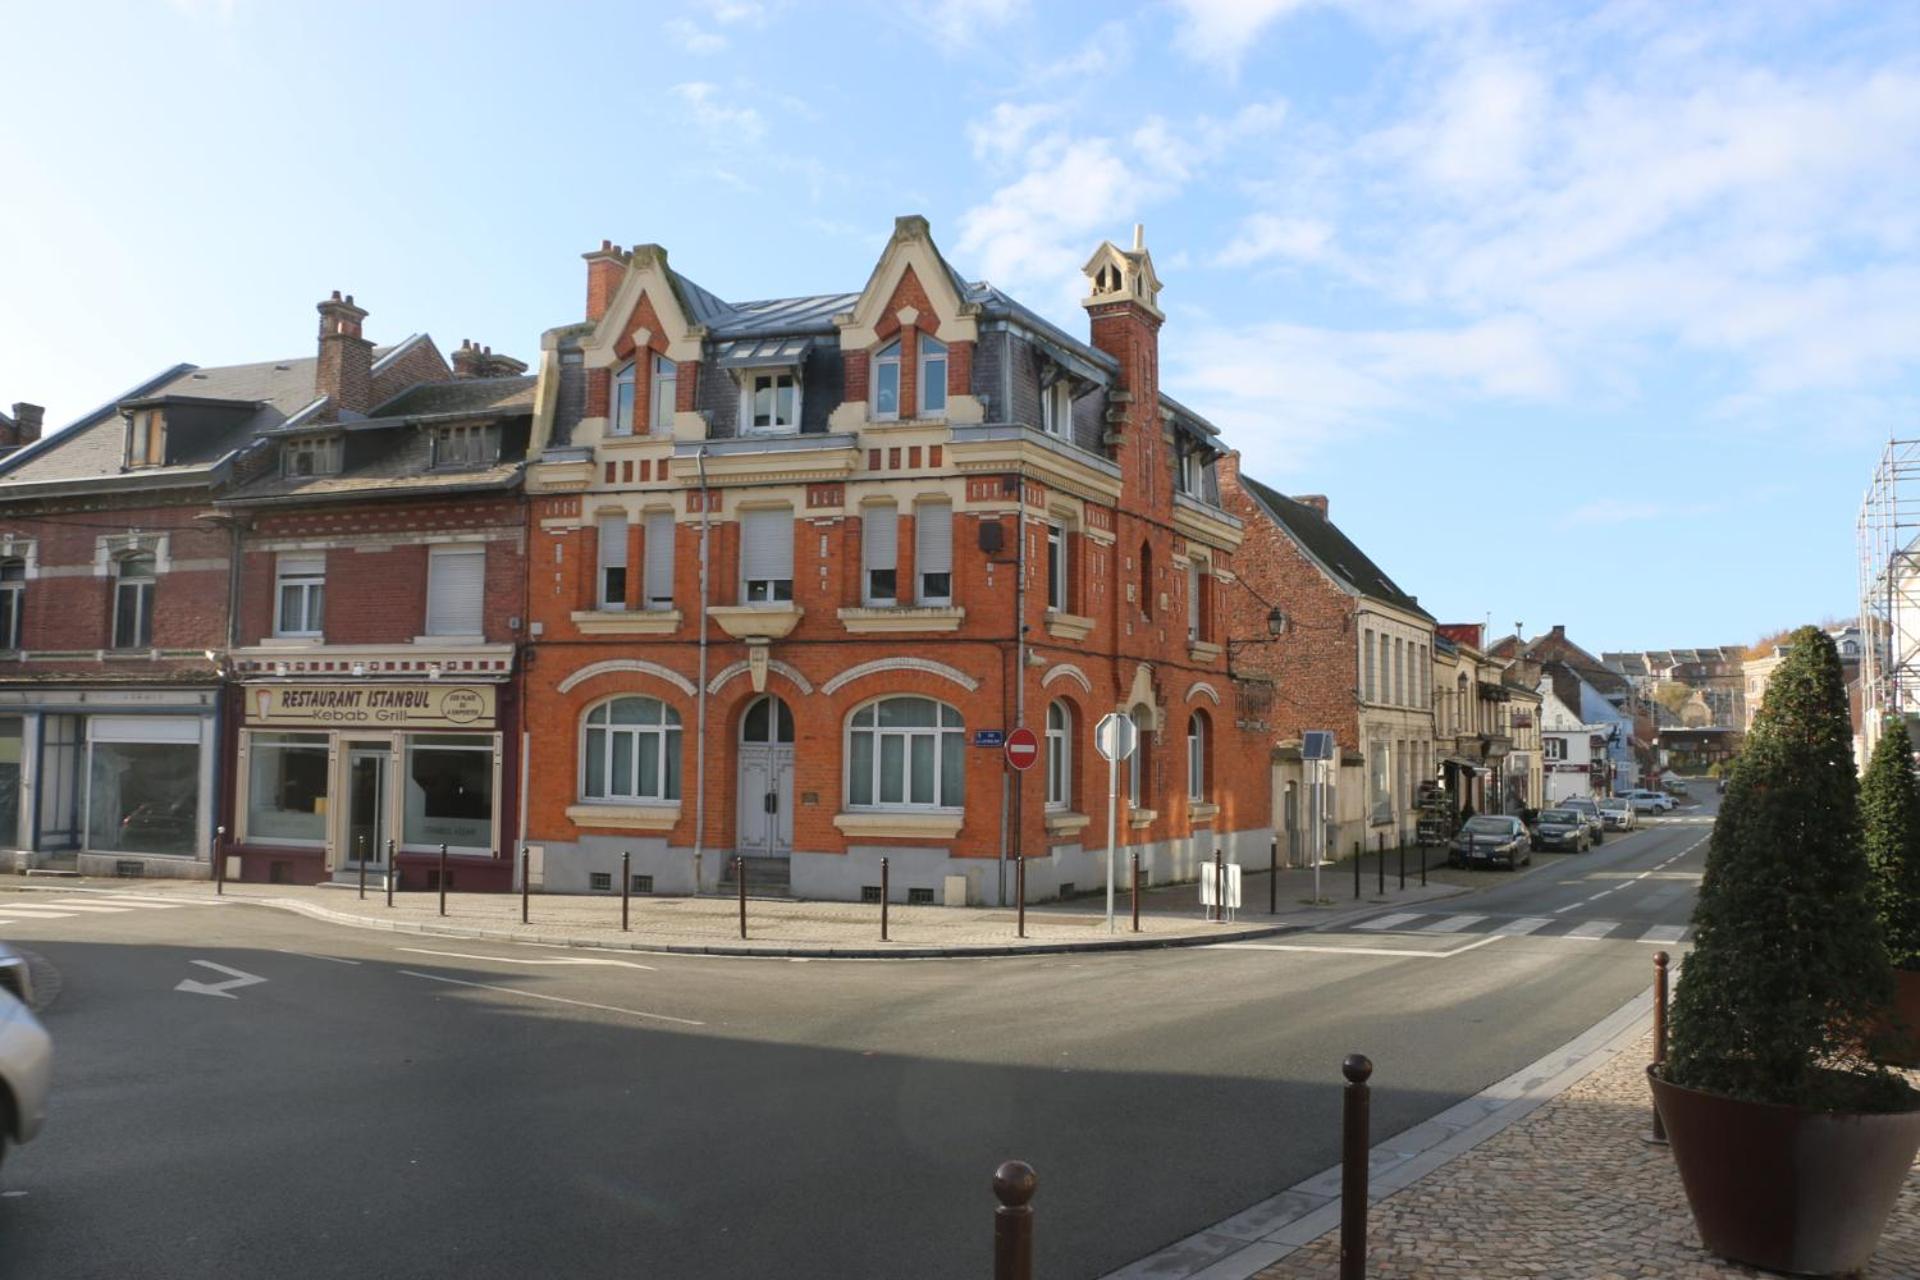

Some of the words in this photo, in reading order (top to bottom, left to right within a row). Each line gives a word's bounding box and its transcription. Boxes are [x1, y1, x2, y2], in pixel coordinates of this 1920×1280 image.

[282, 691, 363, 708] RESTAURANT
[367, 691, 430, 709] ISTANBUL
[313, 709, 369, 721] Kebab
[375, 709, 408, 722] Grill
